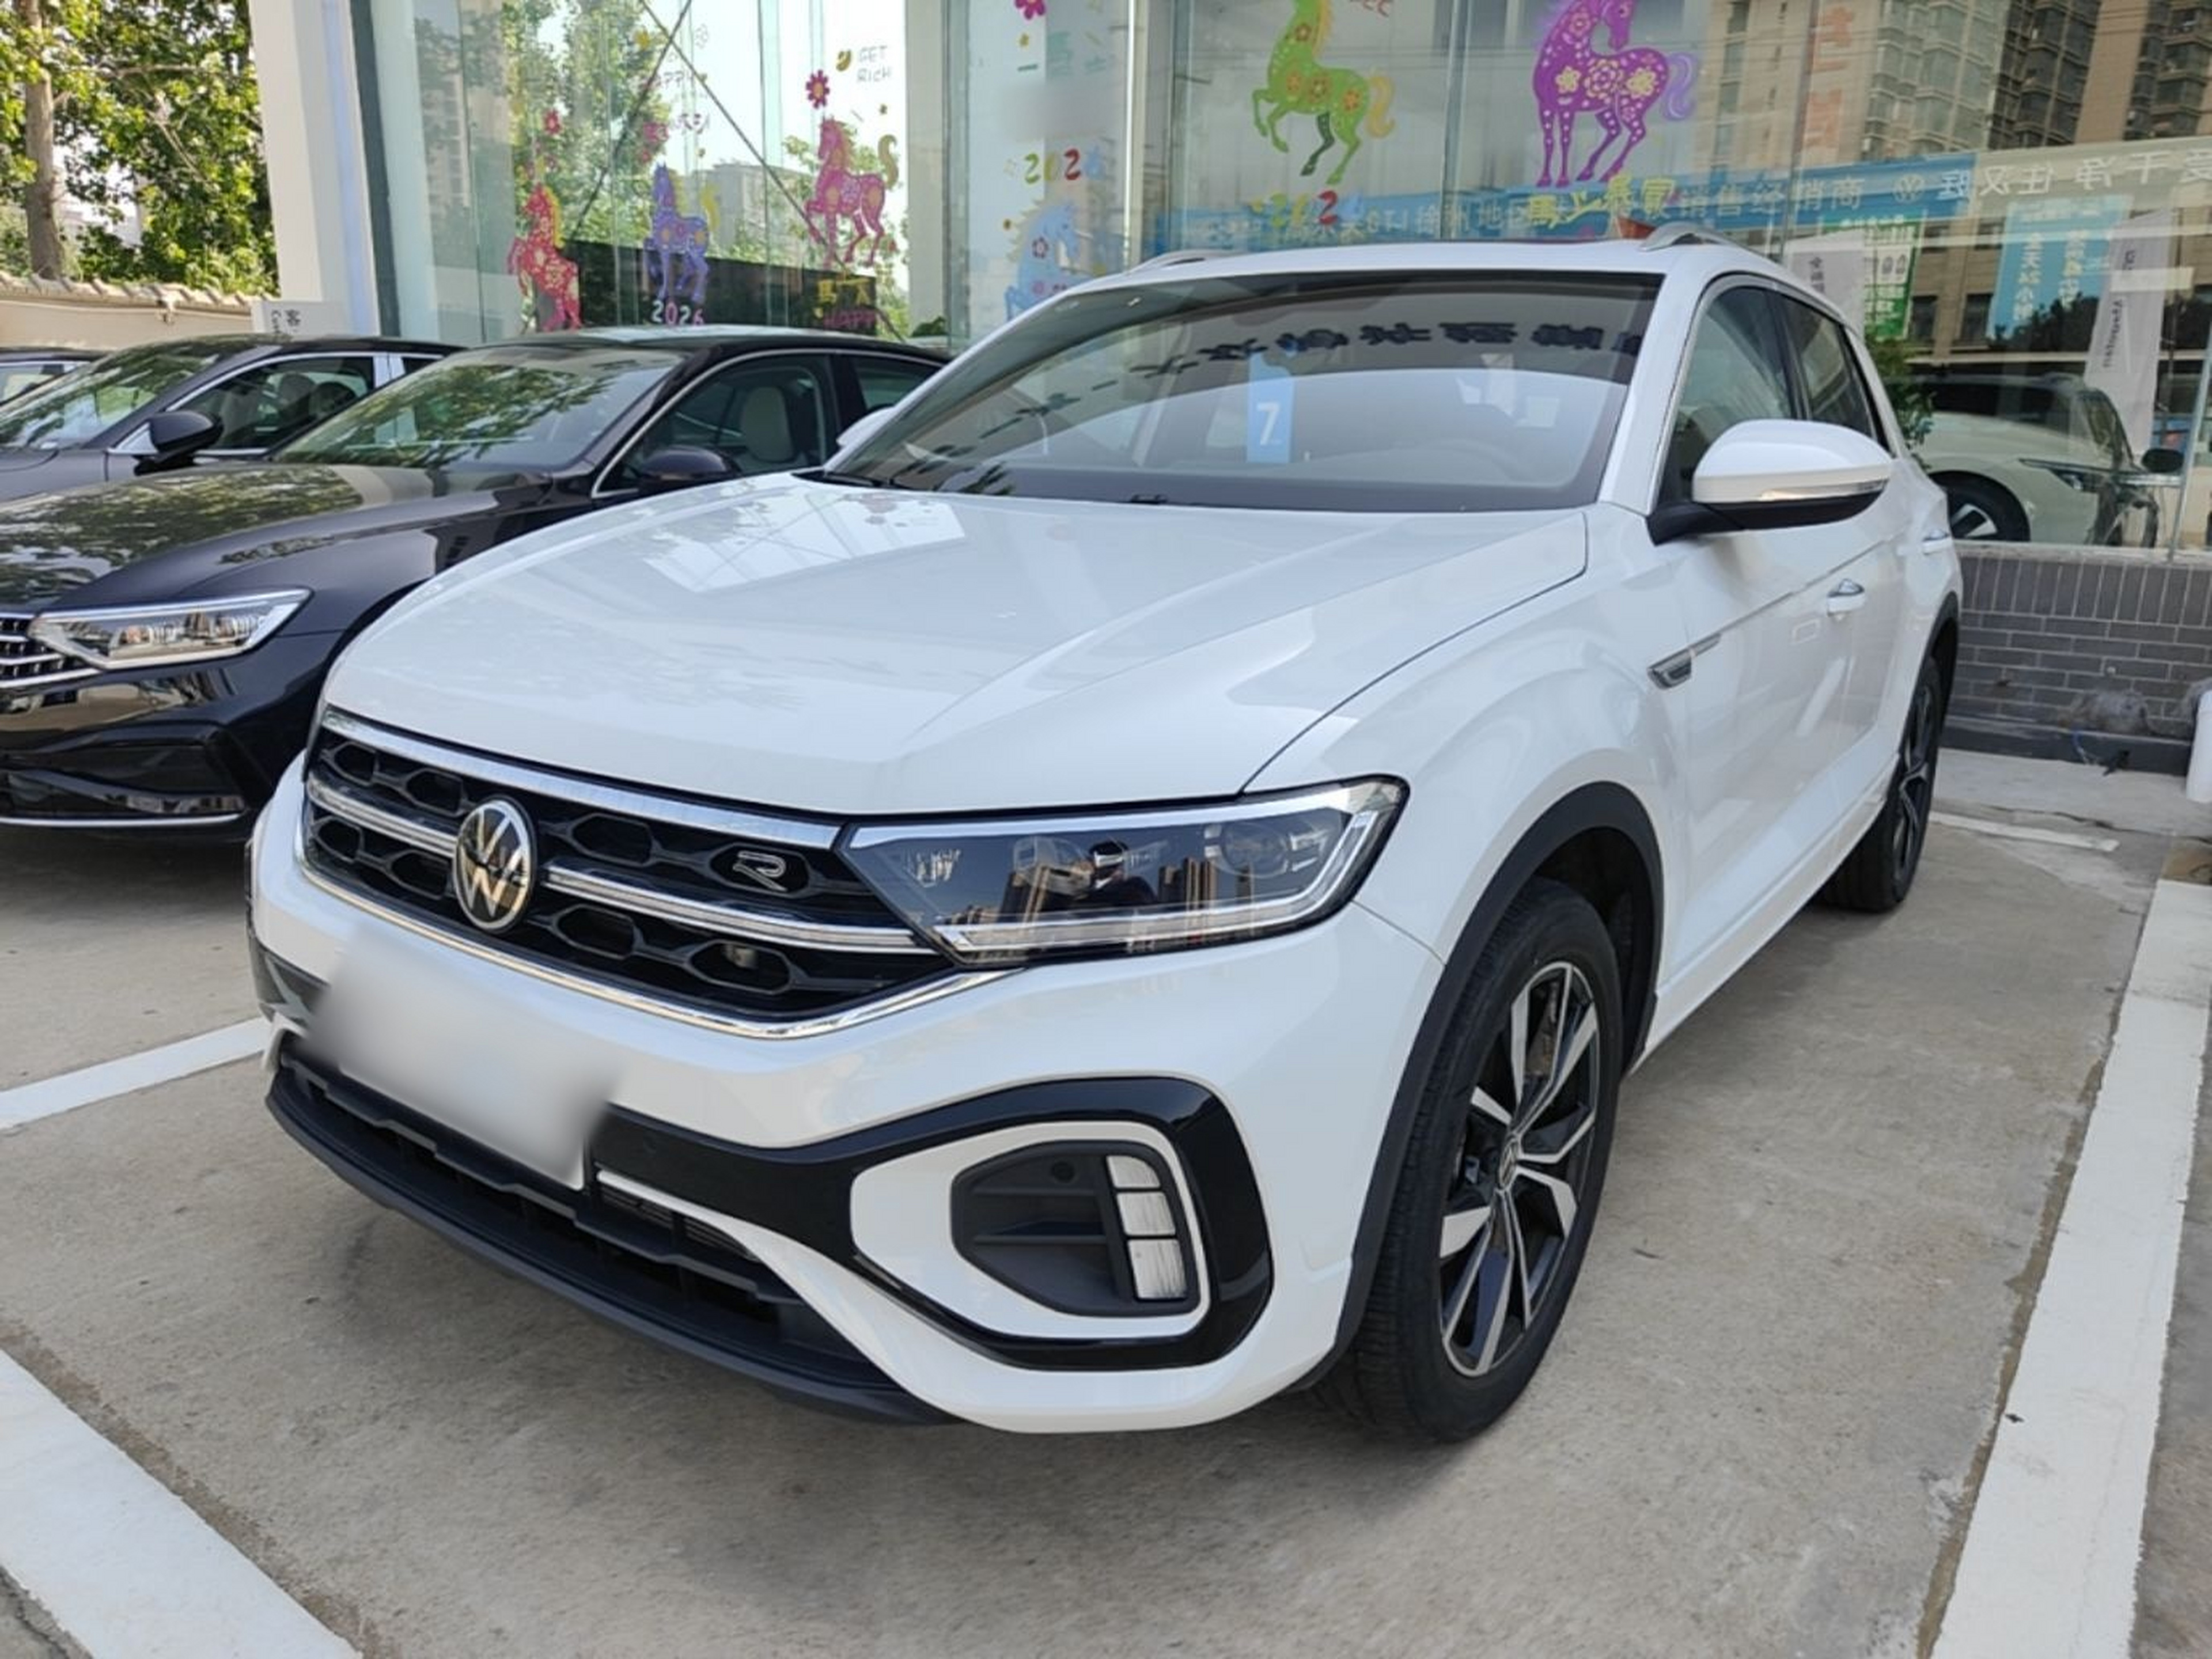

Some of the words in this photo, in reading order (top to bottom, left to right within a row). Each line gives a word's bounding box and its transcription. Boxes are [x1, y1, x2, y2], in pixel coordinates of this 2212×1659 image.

[652, 300, 704, 325] 2026
[1257, 403, 1280, 445] 7
[733, 850, 787, 891] R
